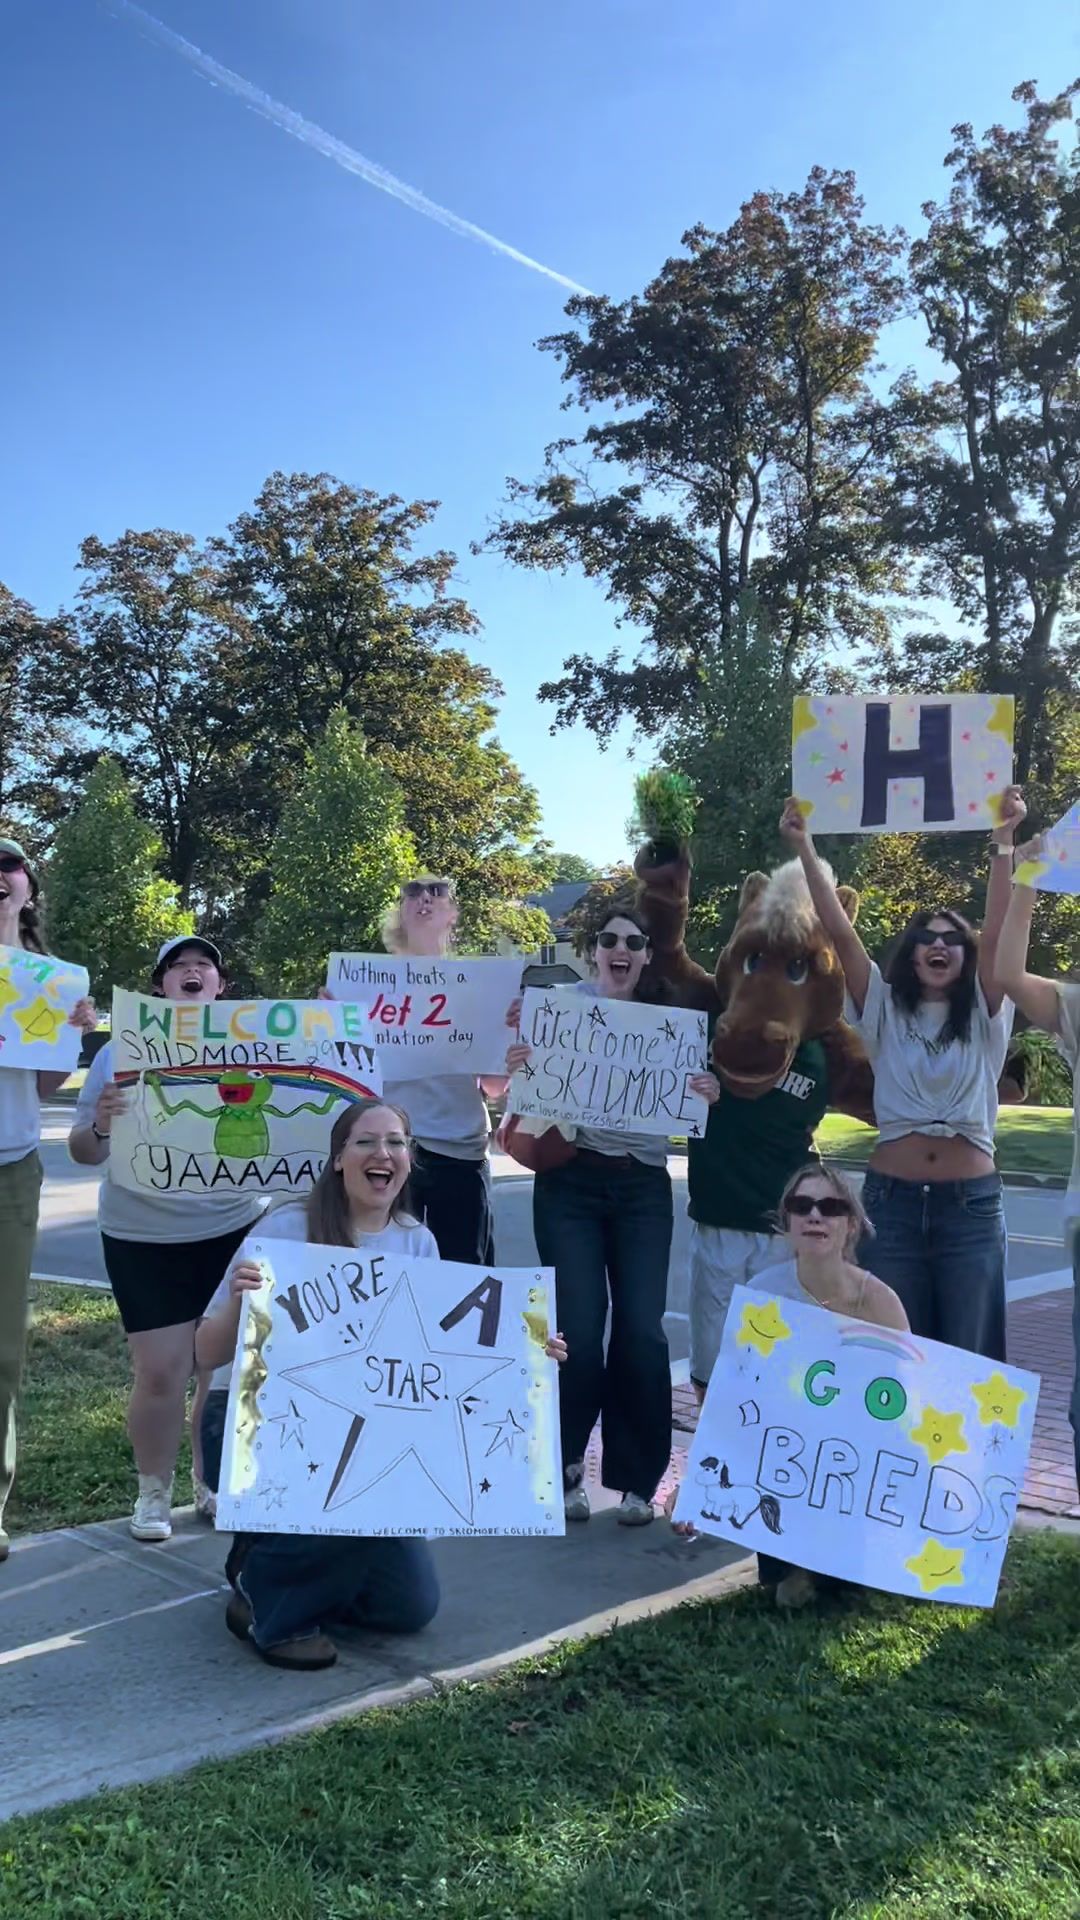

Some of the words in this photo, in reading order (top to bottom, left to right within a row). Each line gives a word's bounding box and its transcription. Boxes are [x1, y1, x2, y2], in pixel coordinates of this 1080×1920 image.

[860, 702, 955, 827] H
[338, 959, 396, 993] Nothing
[406, 962, 447, 985] beats
[457, 970, 467, 982] a
[139, 1002, 362, 1040] WELCOME
[421, 993, 452, 1026] 2
[448, 1028, 474, 1050] day
[532, 1006, 663, 1064] Welcome
[673, 1031, 697, 1069] to
[120, 1029, 296, 1068] SKIDMORE
[536, 1053, 698, 1122] SKIDMORE
[274, 1256, 390, 1334] YOU'RE
[438, 1275, 504, 1348] A
[803, 1360, 908, 1421] GO
[755, 1425, 1018, 1542] BREDS
